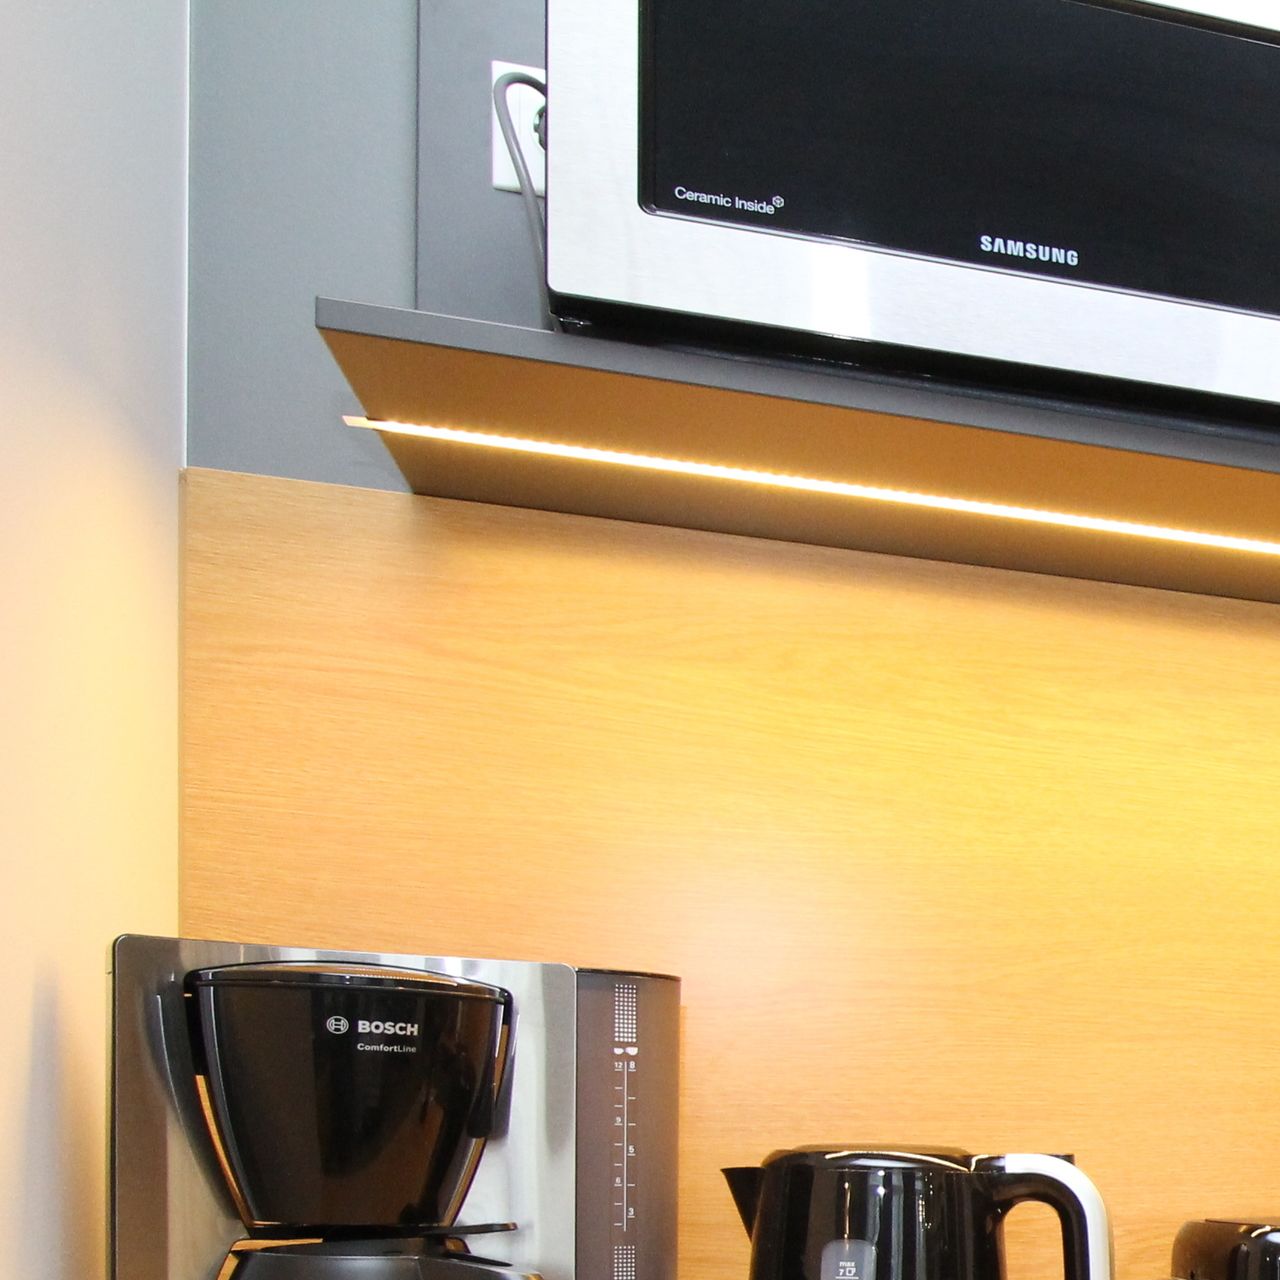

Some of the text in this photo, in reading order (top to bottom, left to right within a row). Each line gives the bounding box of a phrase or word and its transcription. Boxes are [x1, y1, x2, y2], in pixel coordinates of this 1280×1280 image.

[674, 186, 775, 215] Ceramic Inside
[980, 235, 1079, 266] SAMSUNG
[357, 1020, 419, 1036] BOSCH
[357, 1042, 417, 1053] ComfortLine
[629, 1061, 636, 1069] 8
[628, 1145, 635, 1153] 5
[627, 1207, 634, 1216] 3
